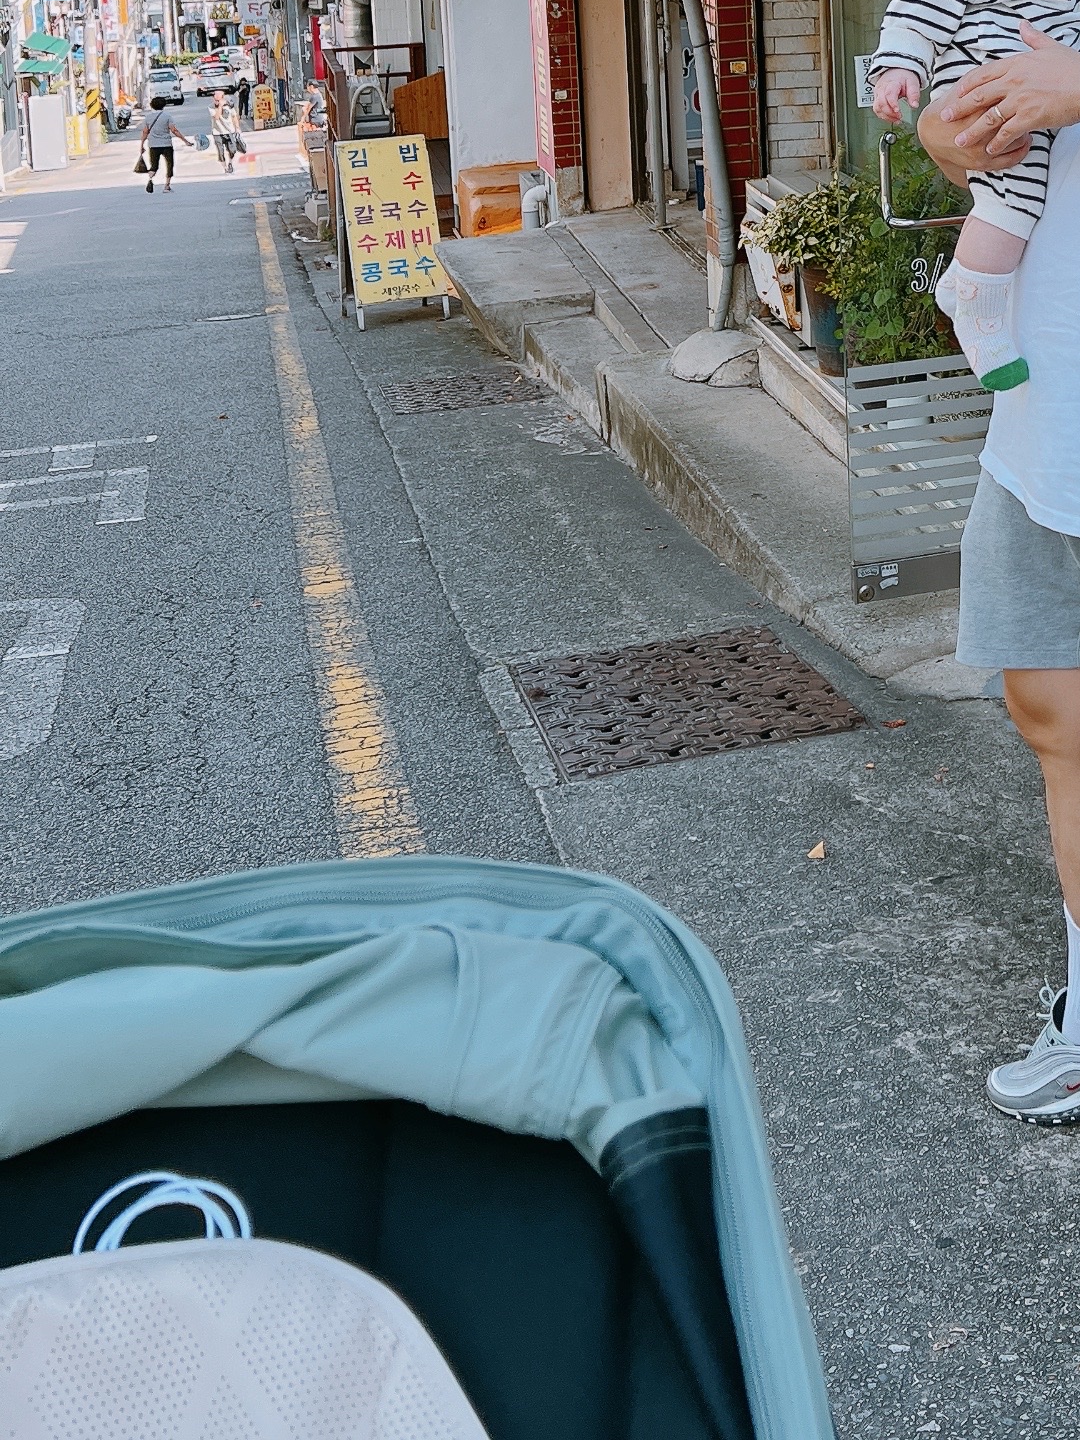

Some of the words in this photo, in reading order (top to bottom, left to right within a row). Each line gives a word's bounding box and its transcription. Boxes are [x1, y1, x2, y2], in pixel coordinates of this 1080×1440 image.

[353, 199, 429, 226] 칼국수
[357, 226, 433, 254] 수제비
[360, 255, 437, 284] 콩국수
